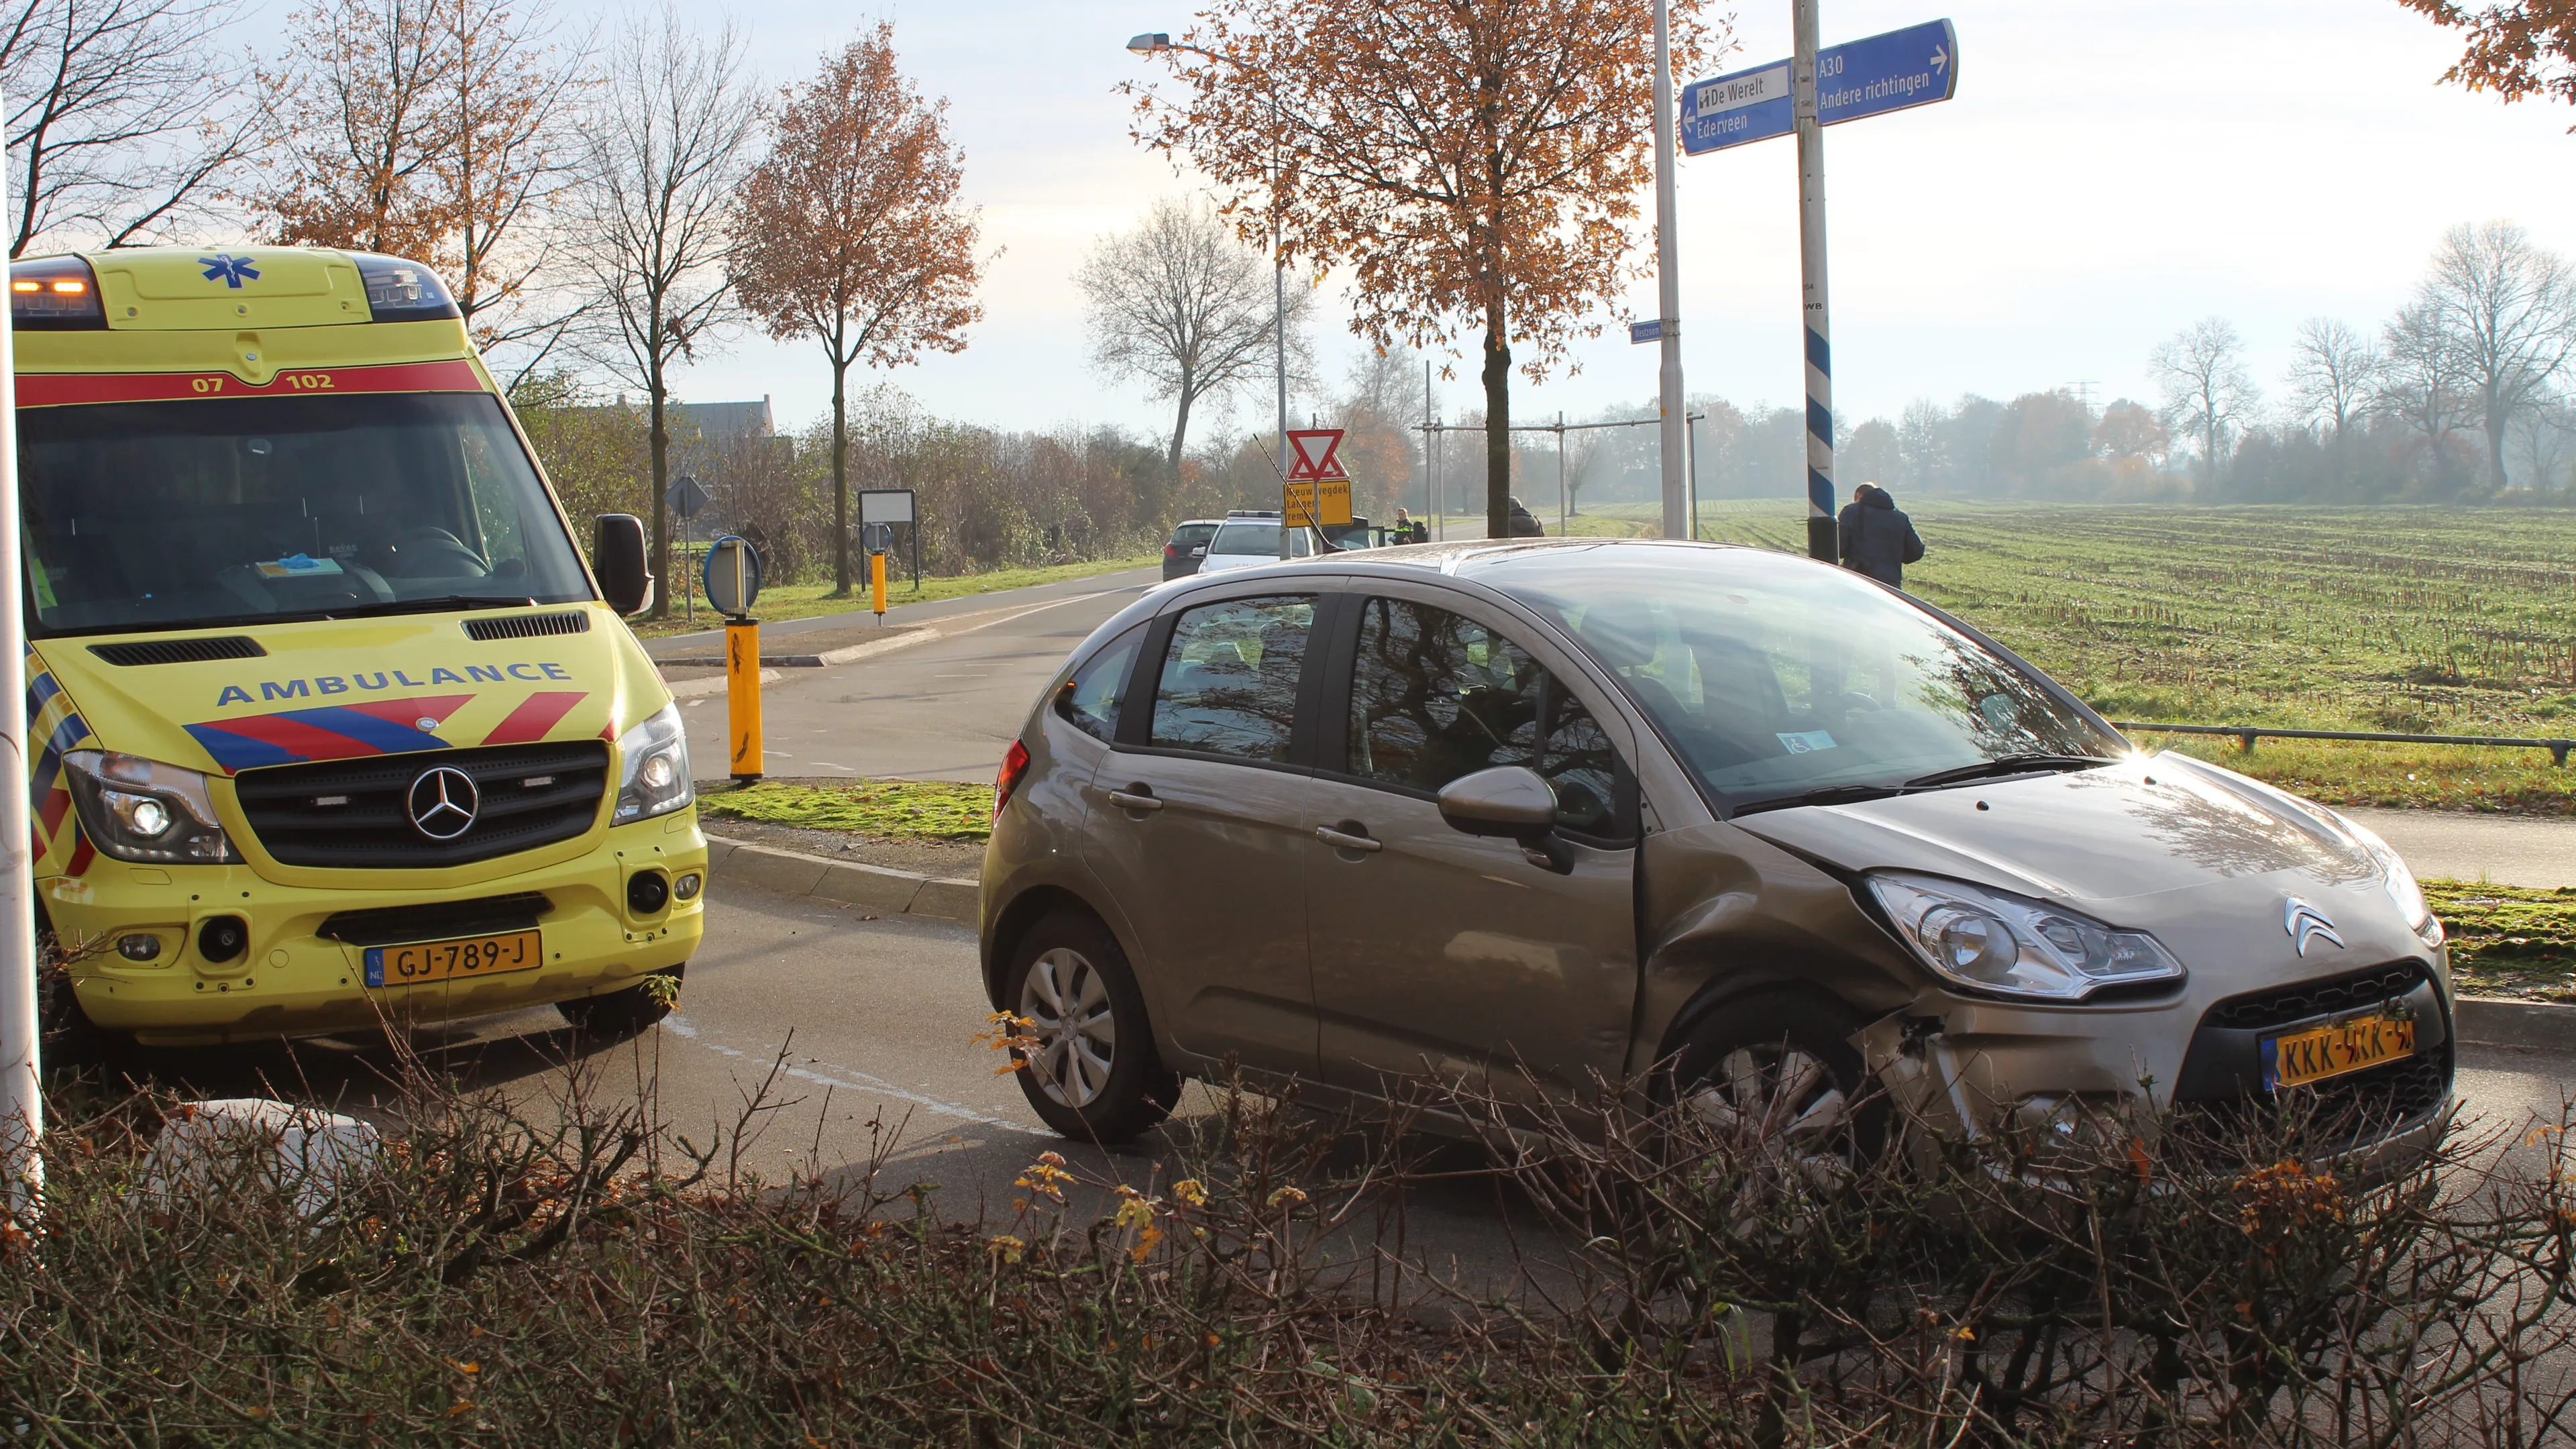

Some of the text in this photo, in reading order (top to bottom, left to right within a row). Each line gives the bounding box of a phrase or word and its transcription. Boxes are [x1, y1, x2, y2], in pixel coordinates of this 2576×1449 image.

[1819, 56, 1843, 78] A30
[1711, 77, 1764, 106] De Werelt
[1820, 72, 1929, 110] Andere richtingen
[1697, 115, 1748, 140] Ederveen
[1635, 327, 1660, 338] Westzoom
[192, 374, 335, 393] 07 102
[1286, 487, 1312, 497] Neuw
[217, 662, 574, 707] AMBULANCE
[397, 937, 525, 977] GJ-789-J
